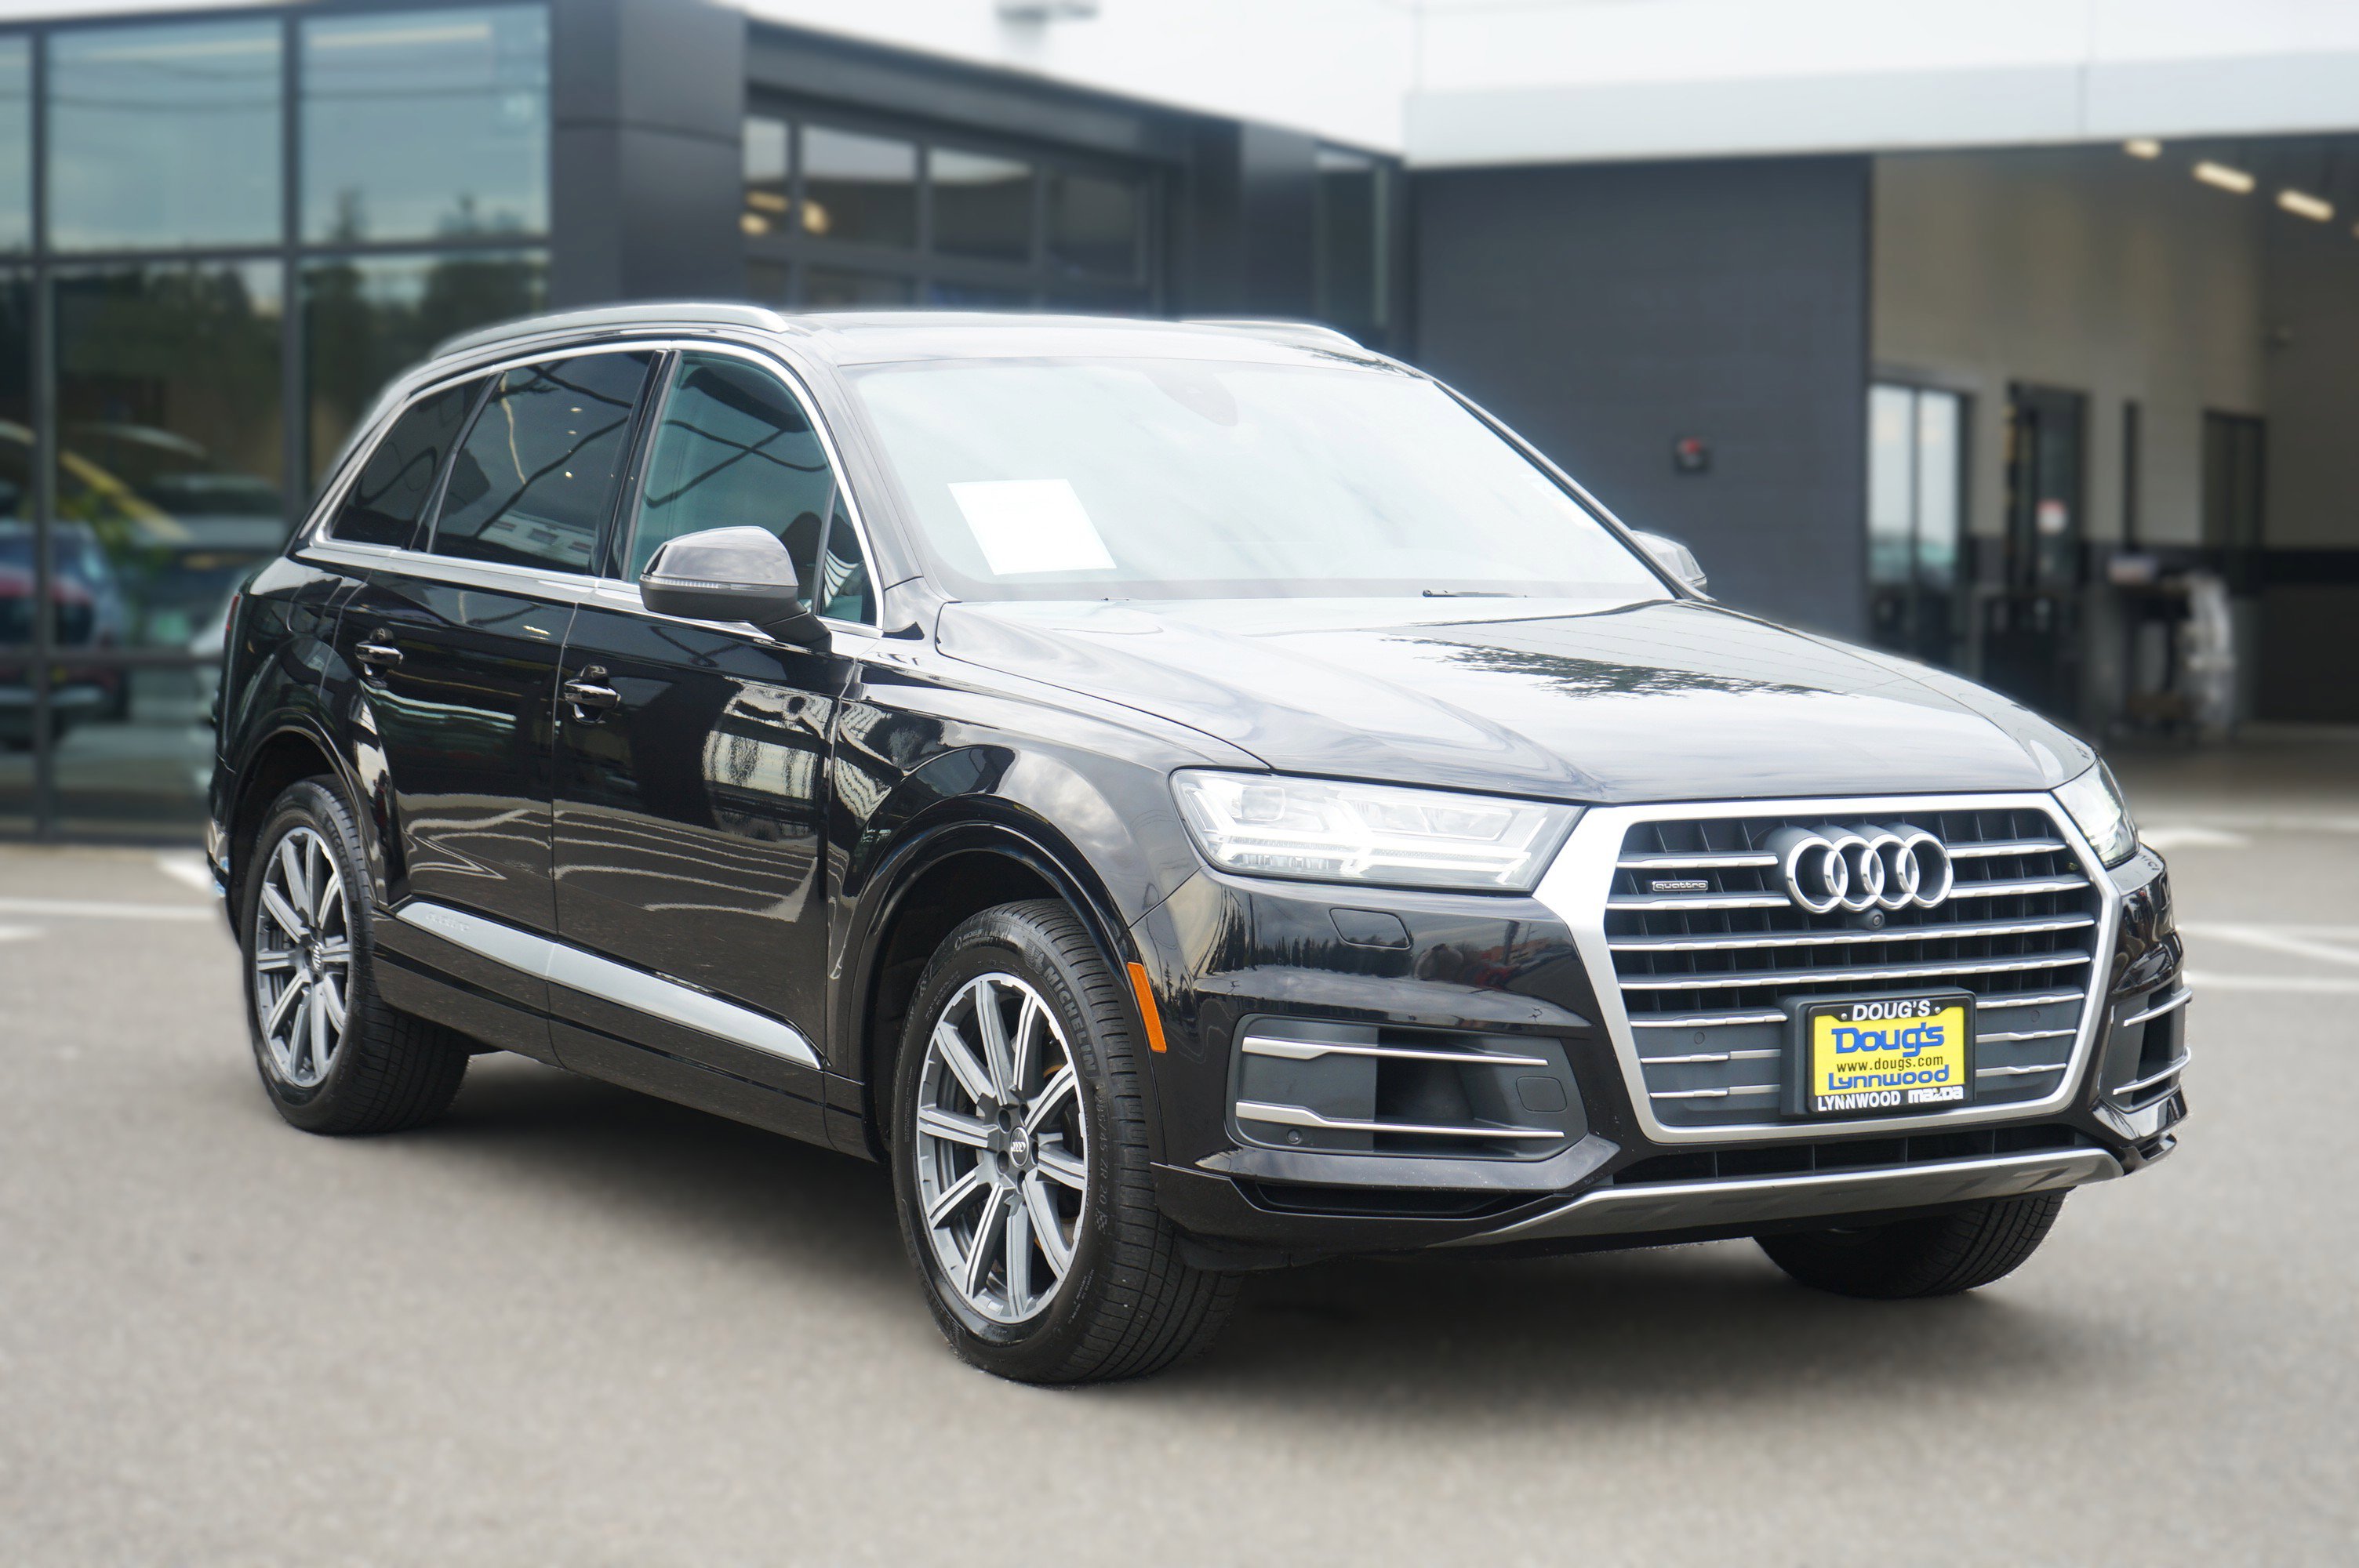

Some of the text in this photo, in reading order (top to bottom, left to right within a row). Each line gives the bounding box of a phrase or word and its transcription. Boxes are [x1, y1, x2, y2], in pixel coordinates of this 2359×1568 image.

[1044, 965, 1096, 1073] MICHELIN
[1852, 1000, 1930, 1021] DOUG'S
[1832, 1022, 1944, 1057] Doug's
[1837, 1056, 1943, 1072] www.dougs.com
[1829, 1065, 1949, 1090] Lynnwood
[1818, 1091, 1900, 1111] LYNNWOOD
[1099, 1184, 1108, 1206] 20
